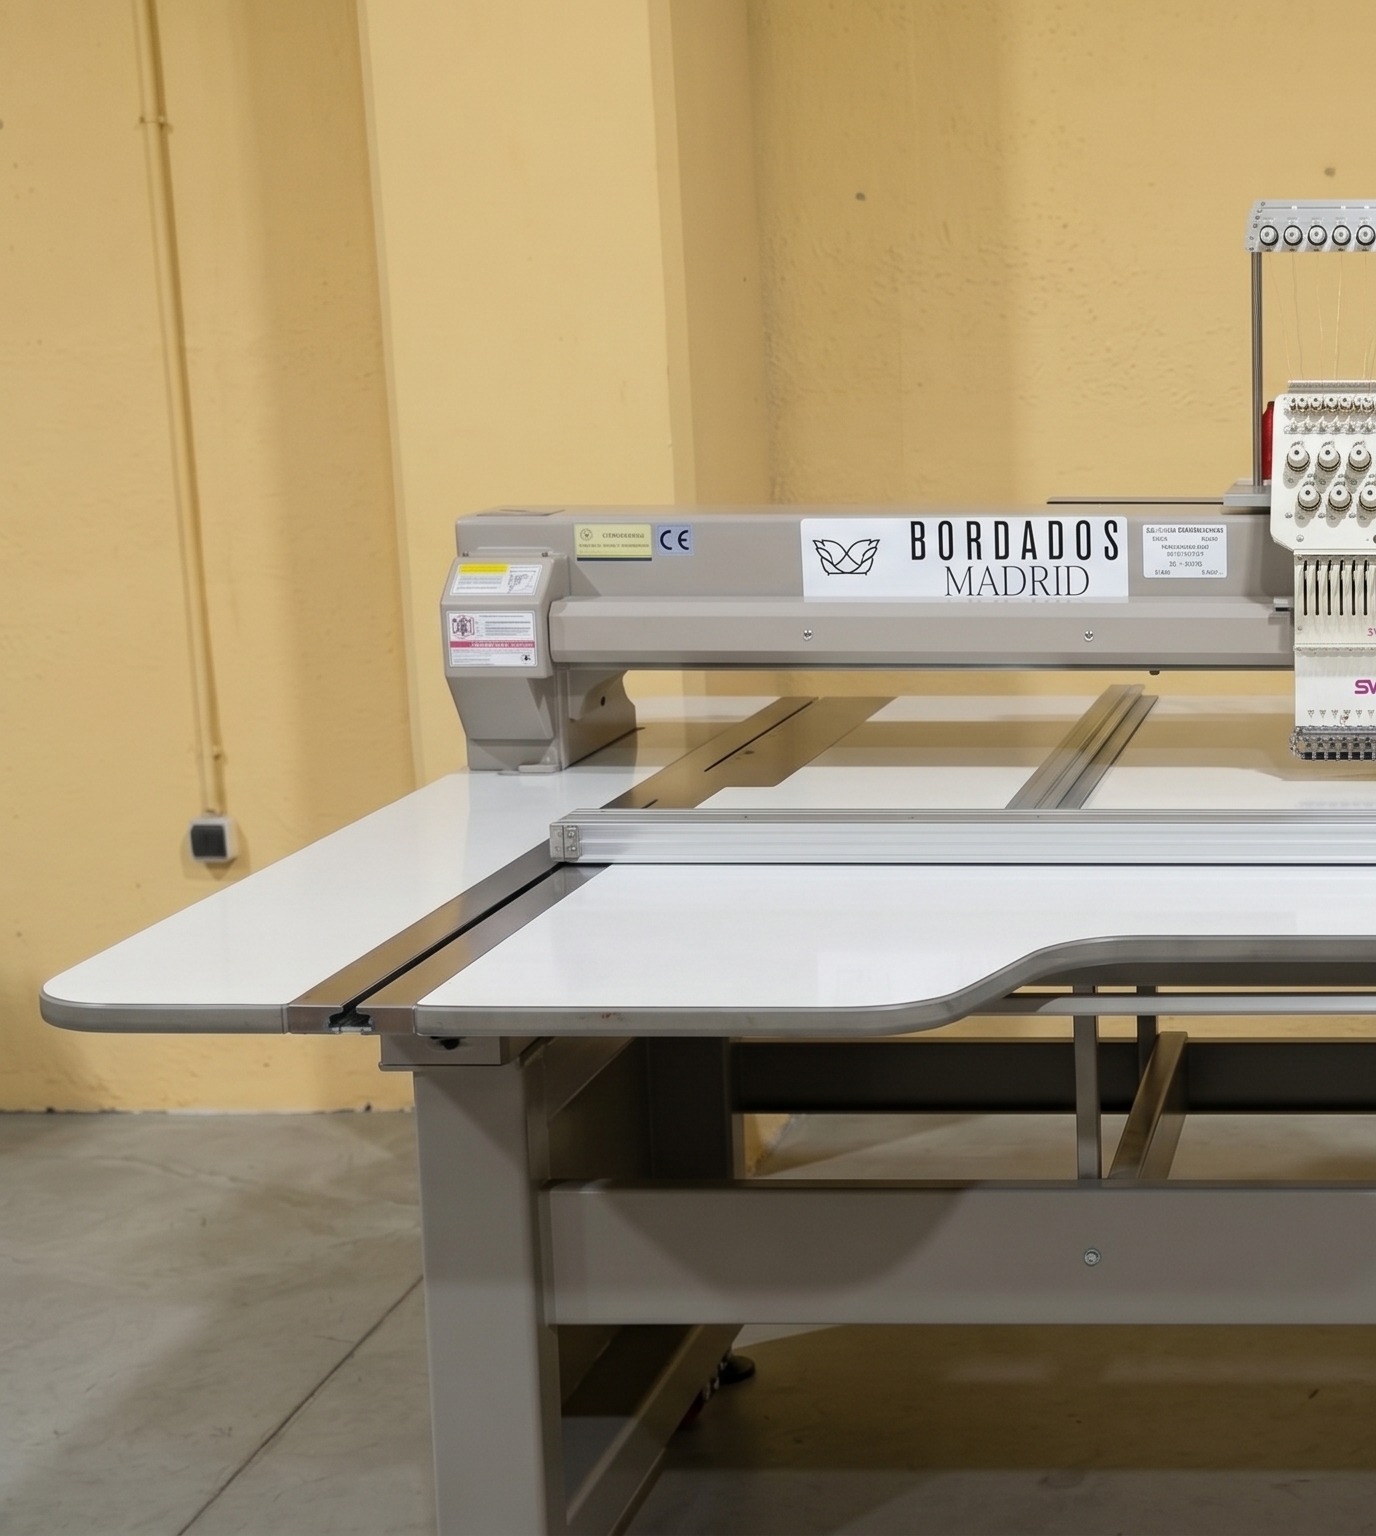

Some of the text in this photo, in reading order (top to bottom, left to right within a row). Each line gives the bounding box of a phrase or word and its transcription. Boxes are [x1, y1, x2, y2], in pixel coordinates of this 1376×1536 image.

[659, 529, 690, 551] CE
[910, 520, 1118, 560] BORDADOS
[944, 566, 1090, 597] MADRID
